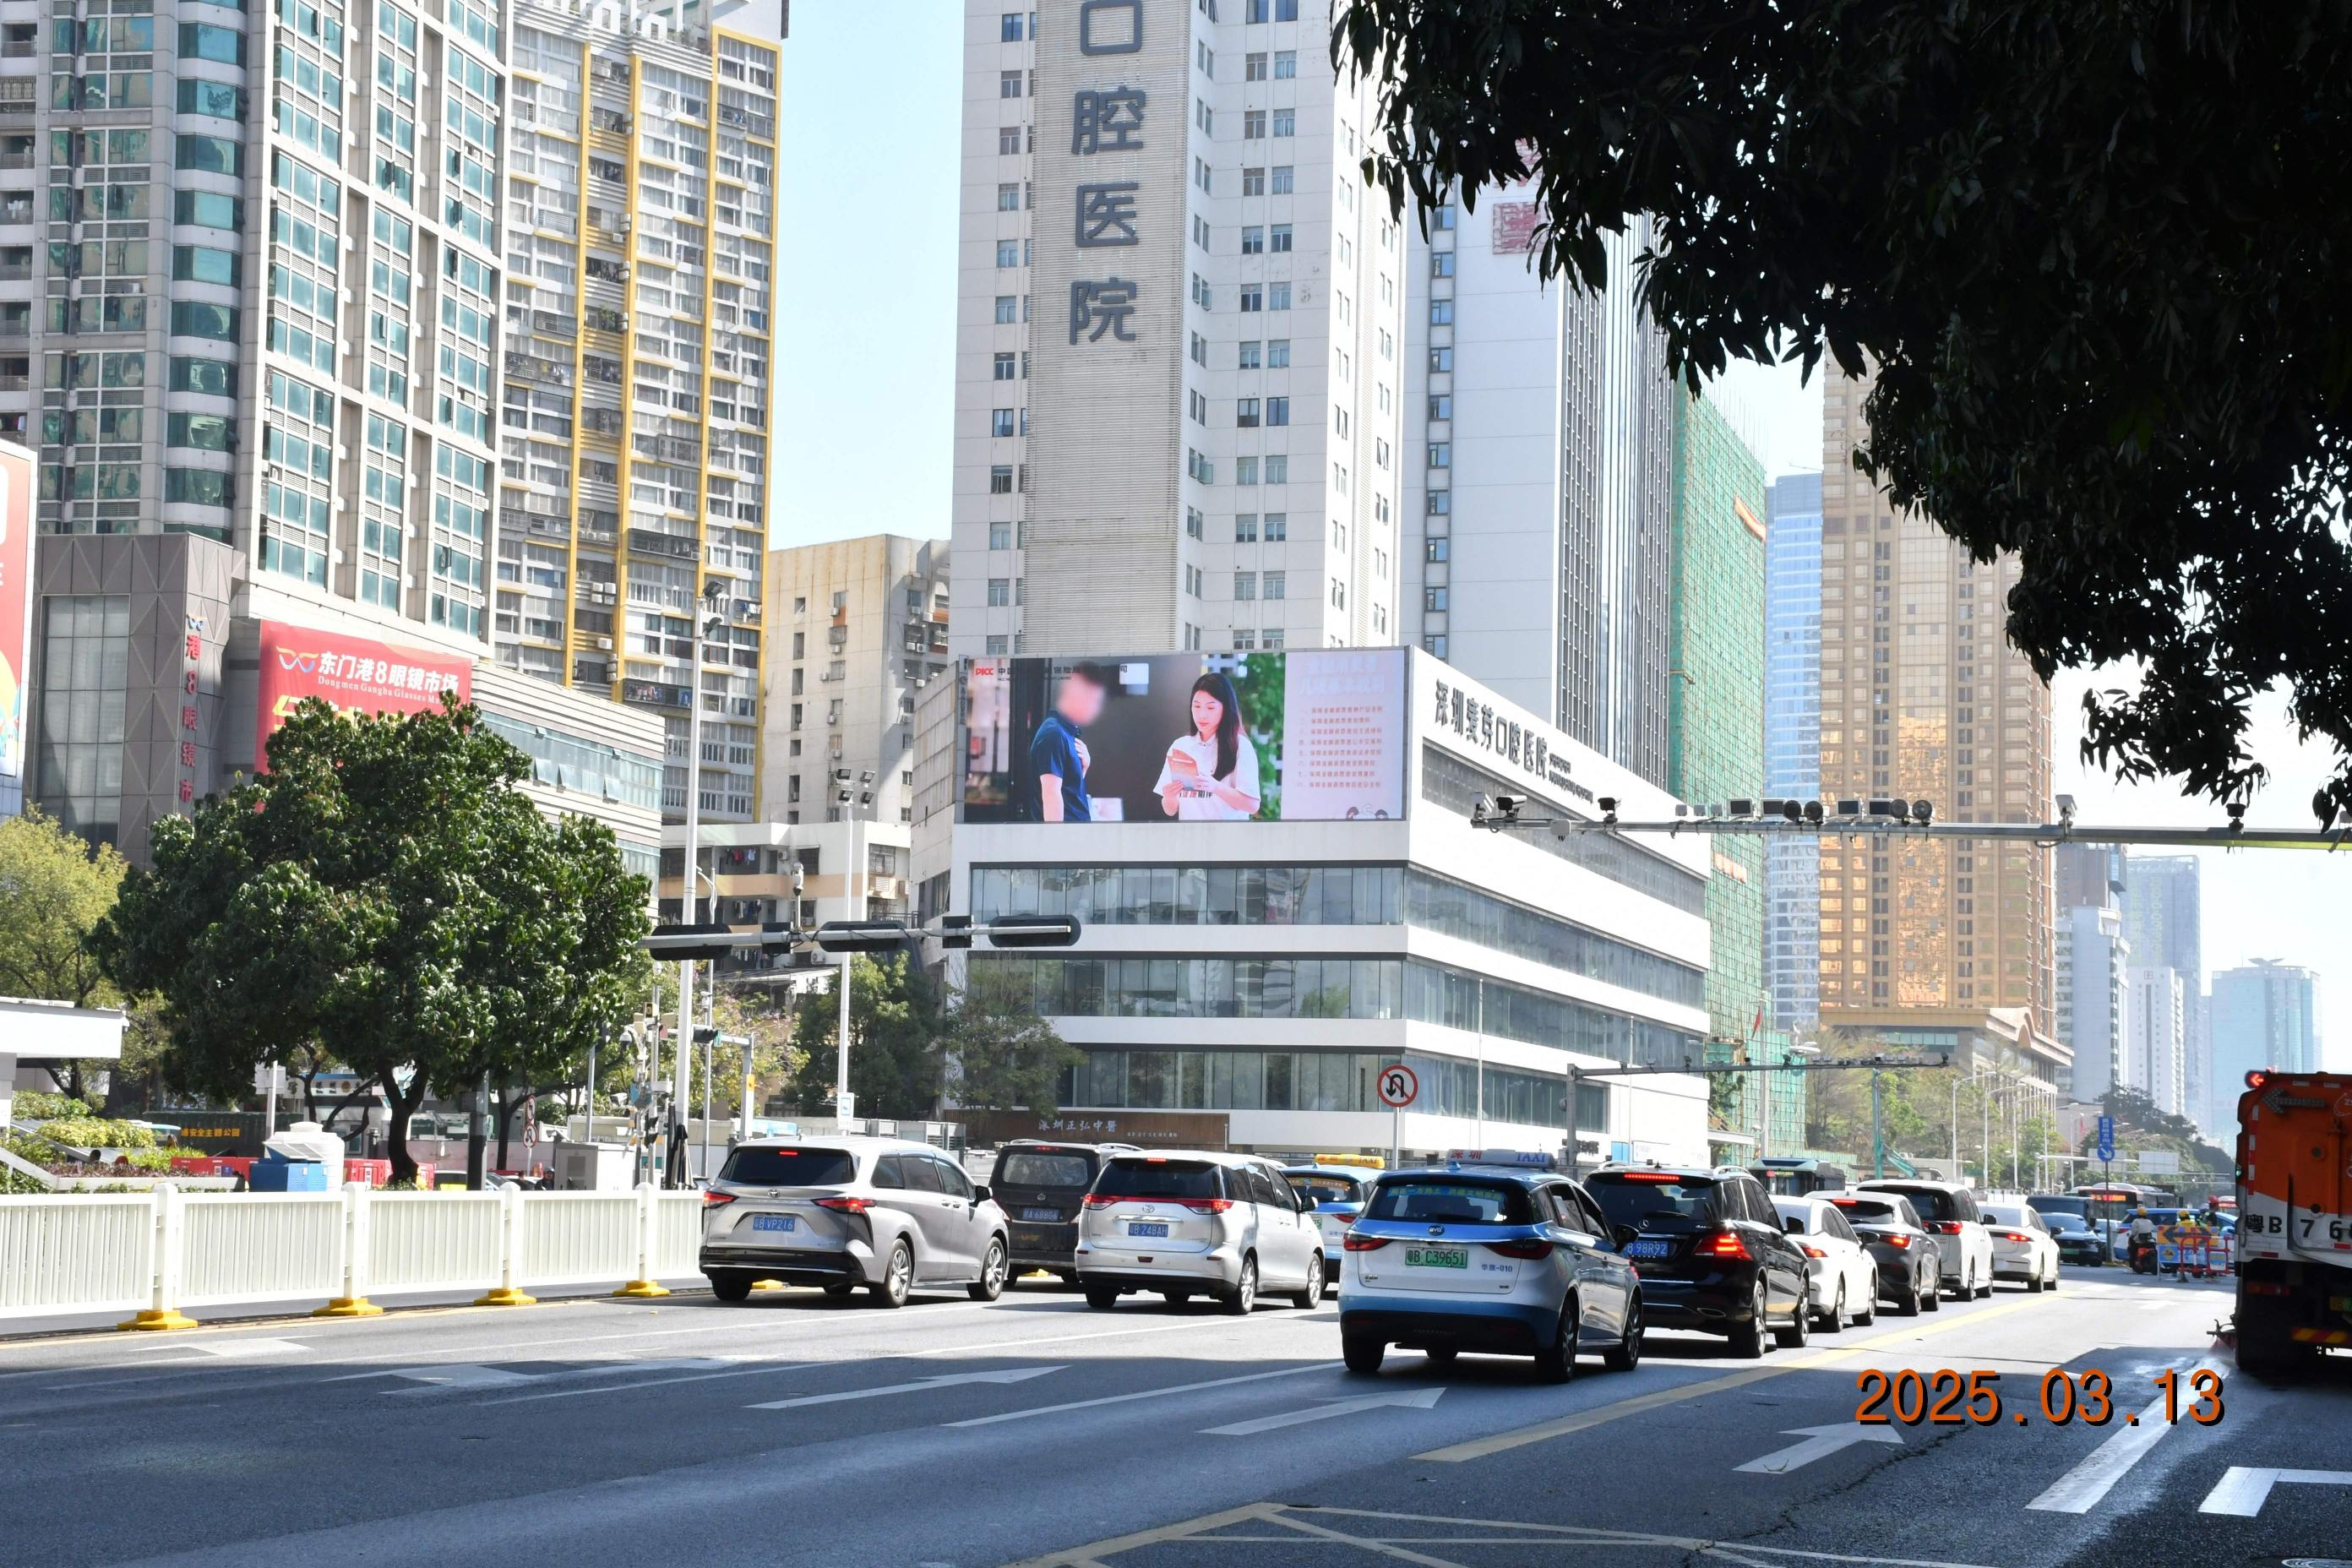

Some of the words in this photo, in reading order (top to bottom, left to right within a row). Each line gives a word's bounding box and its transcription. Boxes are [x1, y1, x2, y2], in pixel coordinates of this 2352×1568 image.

[1069, 1, 1146, 346] 口腔医院
[318, 651, 460, 694] 东门港8眼镜市场
[976, 667, 994, 676] PICC
[318, 676, 359, 691] Dongmen
[360, 683, 393, 698] Gangba
[1451, 1150, 1483, 1161] 深圳
[1516, 1152, 1546, 1163] TAXI
